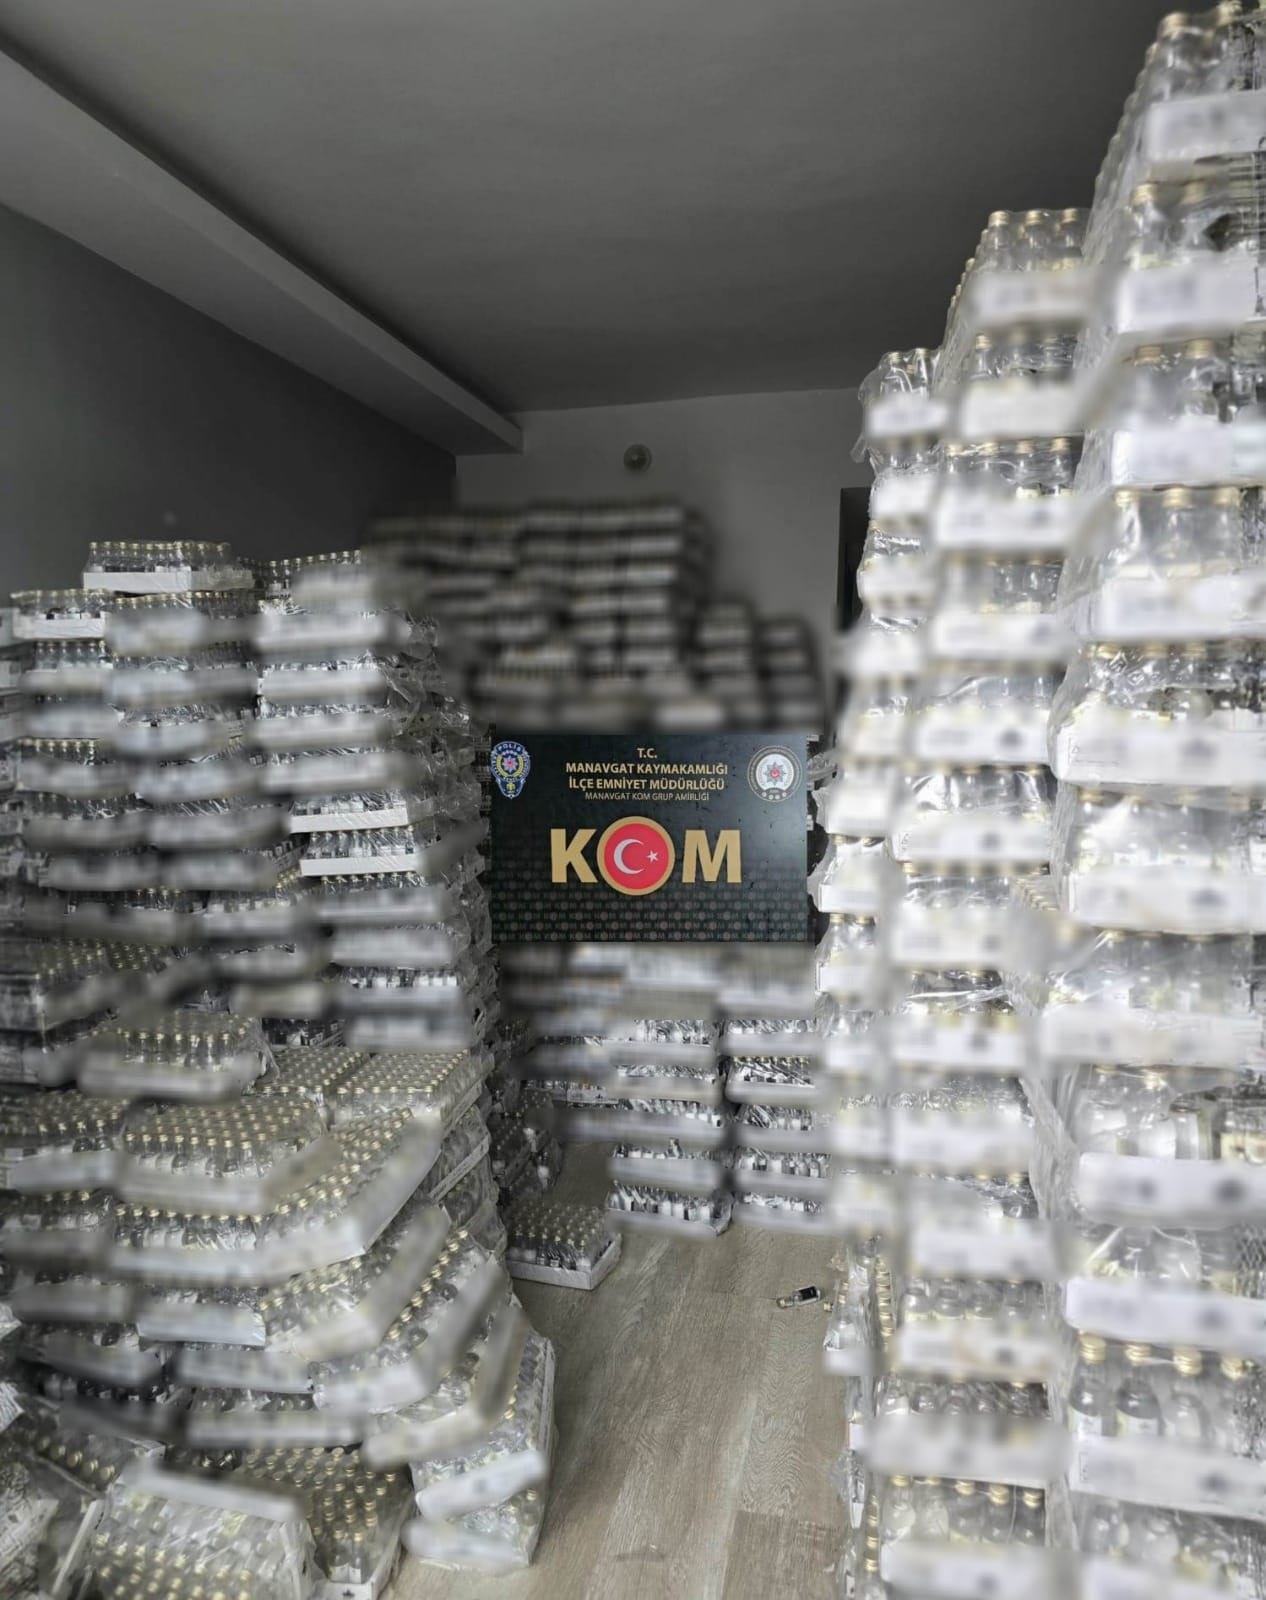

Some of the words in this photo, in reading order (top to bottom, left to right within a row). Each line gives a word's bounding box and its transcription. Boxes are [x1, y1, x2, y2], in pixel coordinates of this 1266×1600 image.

[637, 748, 658, 758] T.C.
[566, 763, 634, 774] MANAVGAT
[637, 763, 728, 775] KAYMAKAMLIĞI
[569, 776, 594, 791] İLÇE
[597, 777, 647, 789] EMNİYET
[650, 778, 725, 790] MÜDÜRLÜĞÜ
[585, 792, 630, 800] MANAVGAT
[550, 816, 742, 896] KOM
